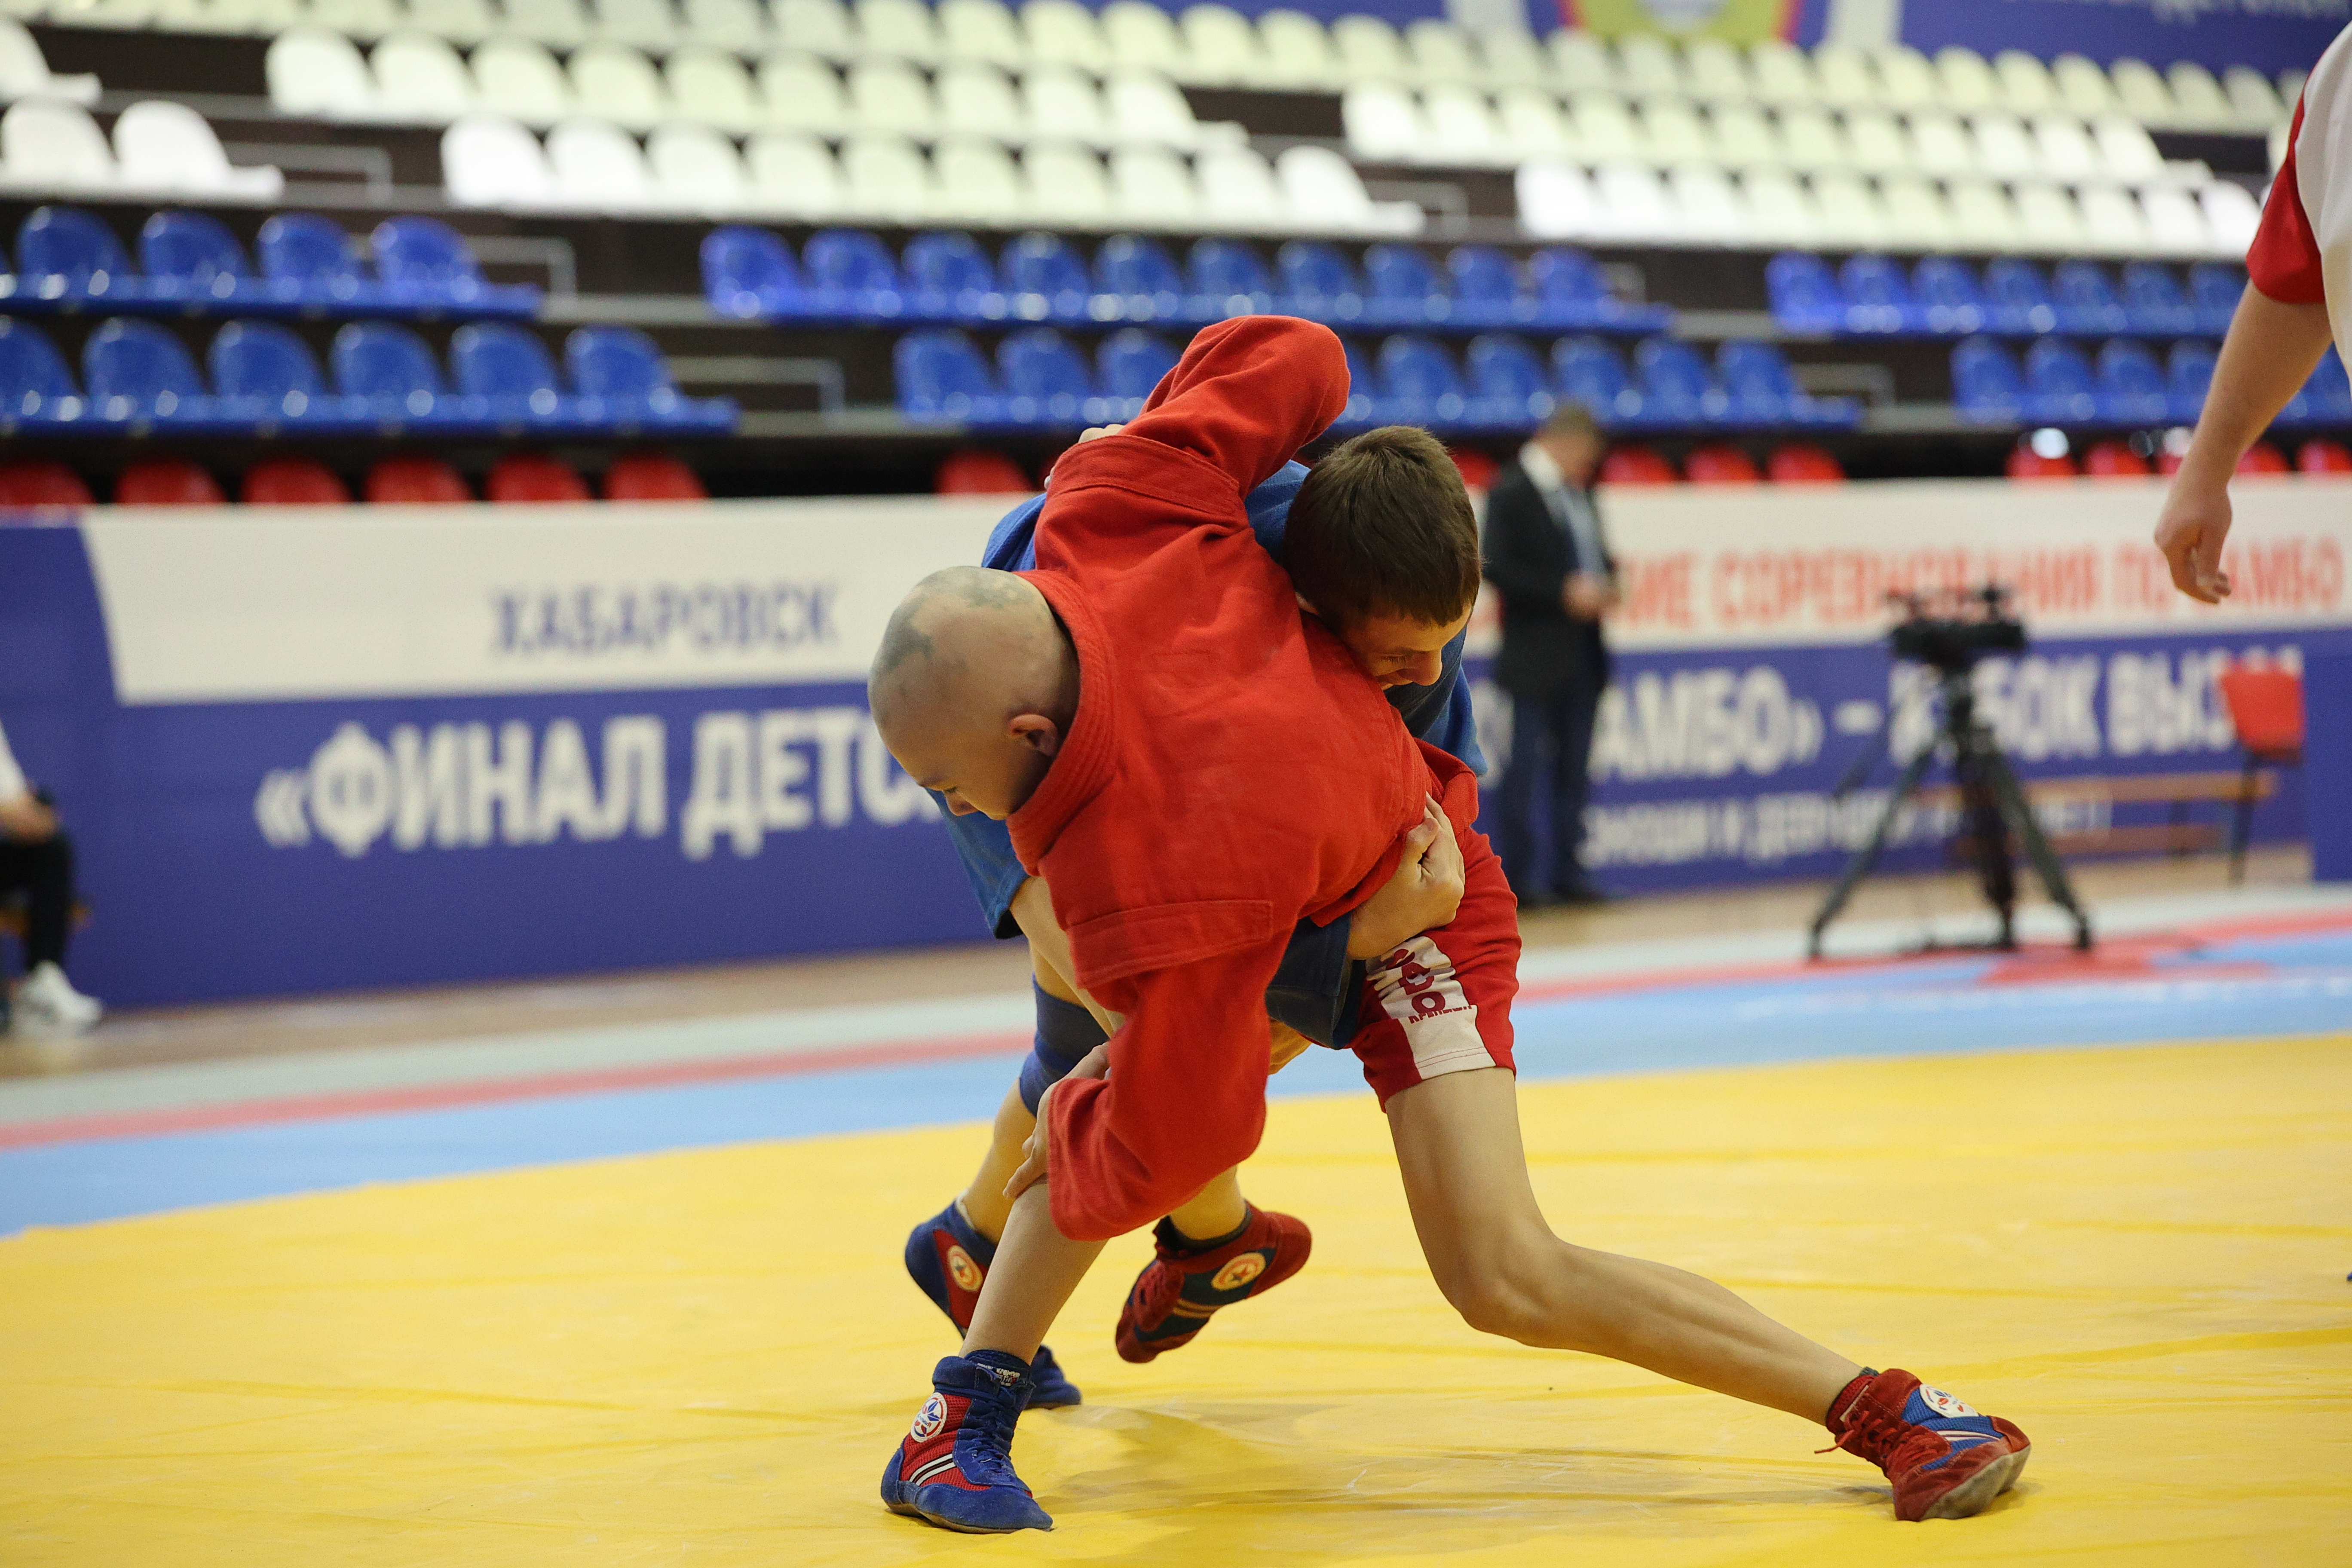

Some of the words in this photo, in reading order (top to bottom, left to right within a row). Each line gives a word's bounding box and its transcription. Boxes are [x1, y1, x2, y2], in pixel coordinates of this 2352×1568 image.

[493, 581, 837, 657] ХАБАРОВСК
[2192, 535, 2345, 614] АМБО
[1585, 664, 1825, 786] АМБО»
[1889, 652, 2104, 769] КБОК
[255, 714, 667, 857] «ФИНАЛ
[682, 705, 941, 861] ДЕТС
